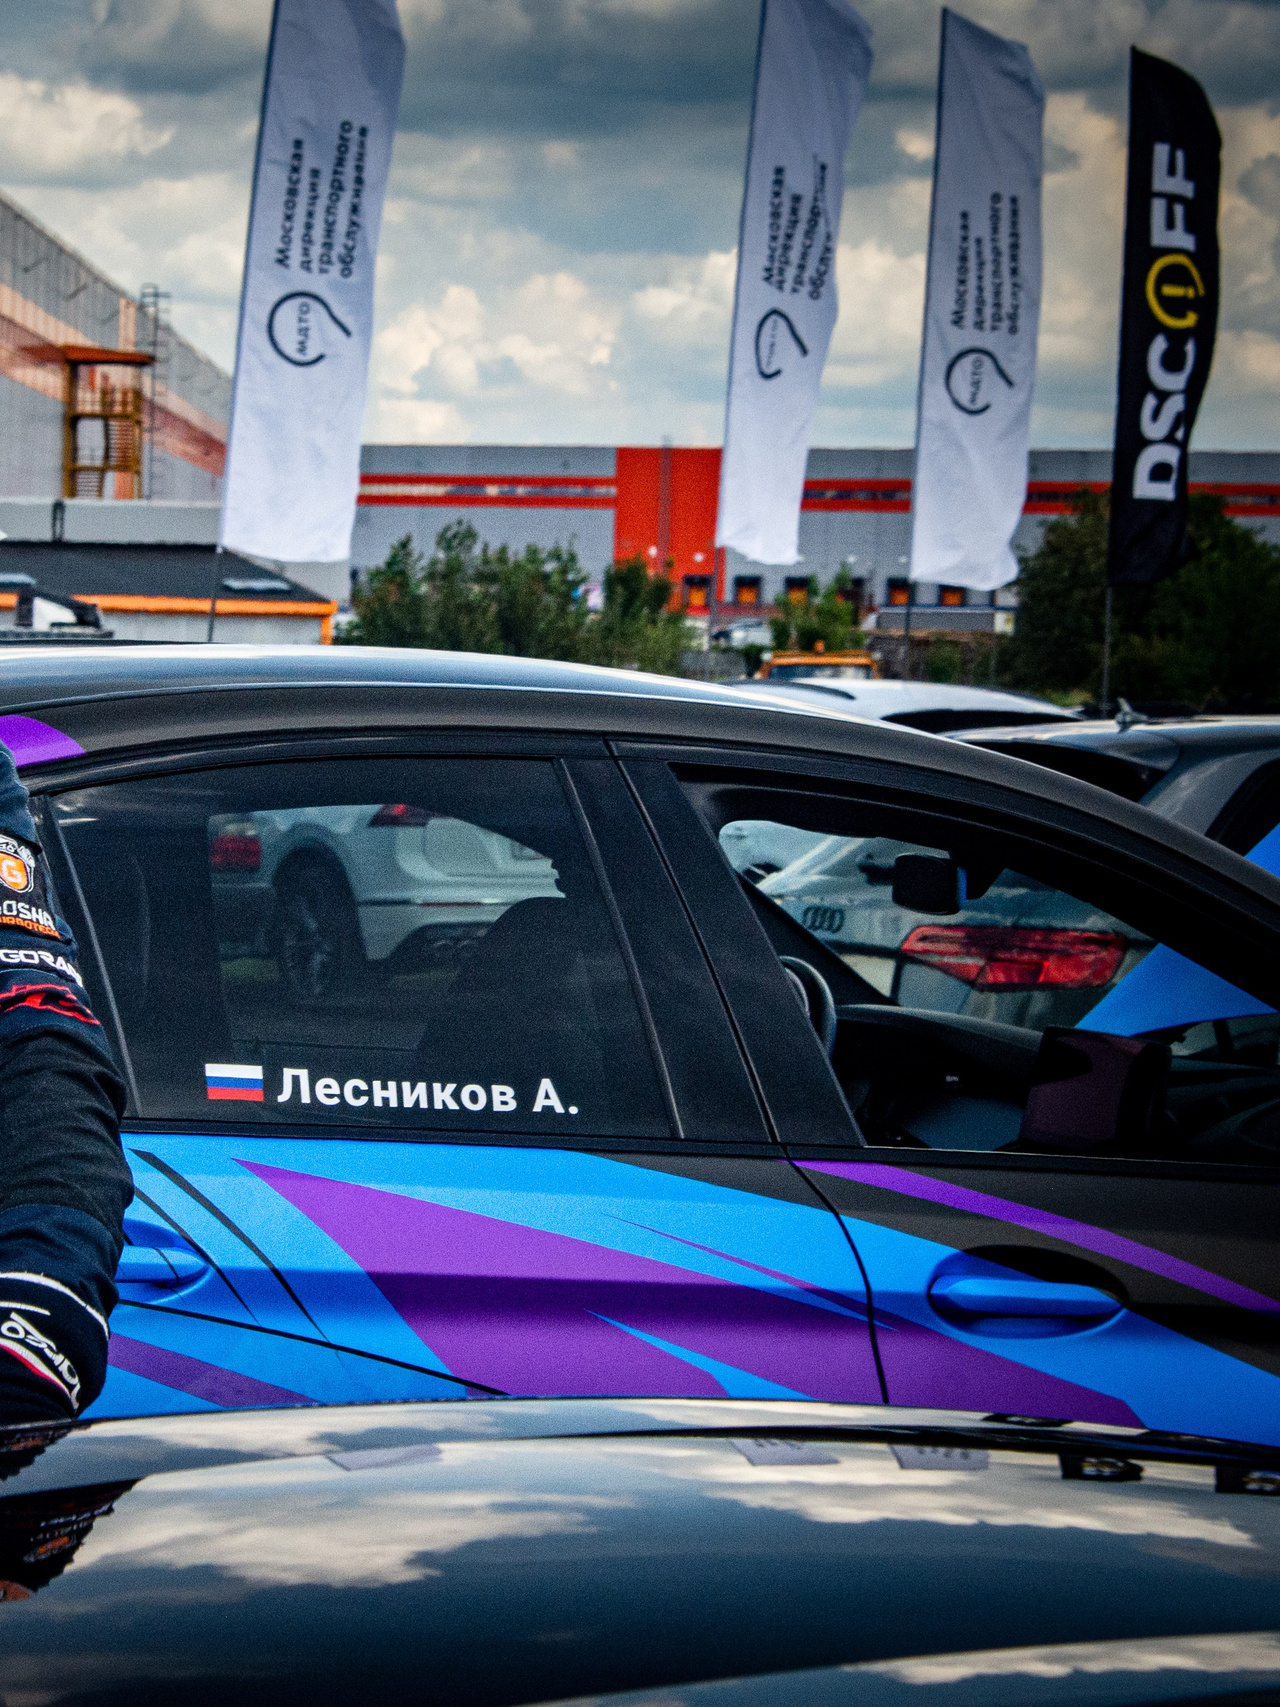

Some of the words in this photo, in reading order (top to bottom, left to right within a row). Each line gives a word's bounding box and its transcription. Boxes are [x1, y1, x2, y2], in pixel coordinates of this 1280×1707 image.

[275, 138, 303, 268] Московская
[300, 167, 321, 273] дирекция
[318, 120, 353, 274] транспортного
[277, 1066, 518, 1113] Лесников
[532, 1078, 580, 1115] А.
